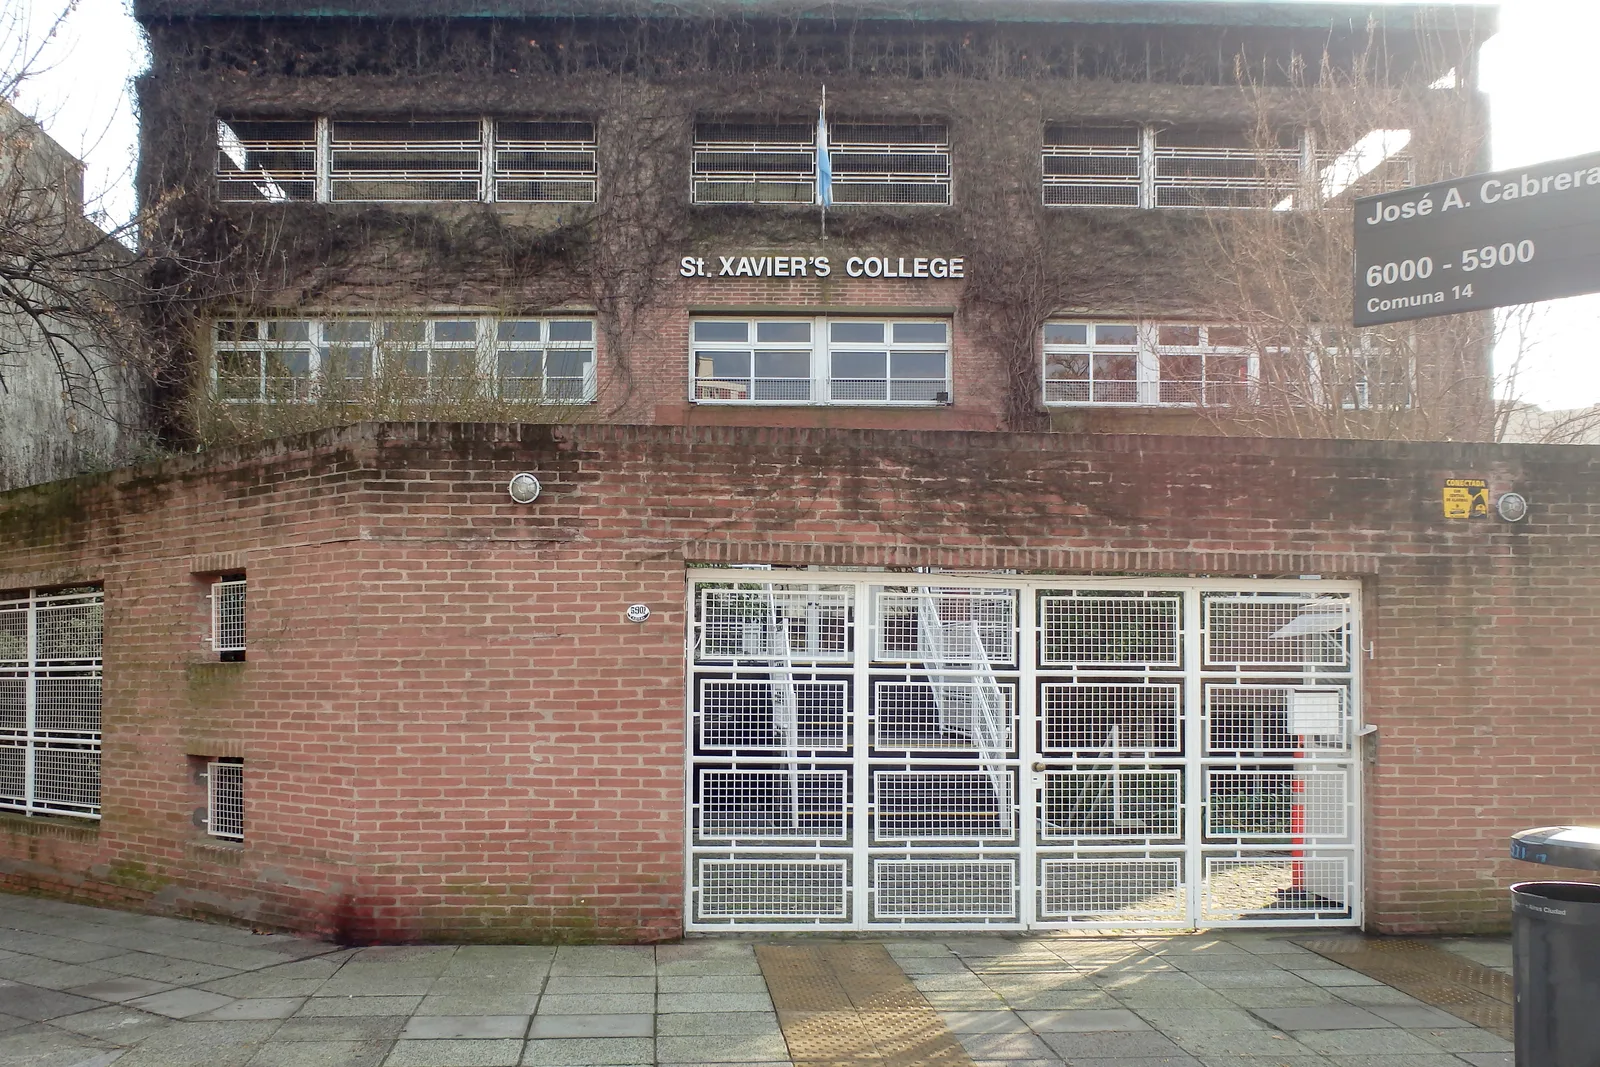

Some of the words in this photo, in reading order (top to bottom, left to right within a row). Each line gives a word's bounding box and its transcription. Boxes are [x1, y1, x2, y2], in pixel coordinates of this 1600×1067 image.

[1366, 192, 1433, 225] José
[1441, 187, 1471, 212] A.
[1480, 166, 1600, 204] Cabrera
[680, 256, 712, 278] St.
[719, 256, 831, 277] XAVIER'S
[846, 257, 964, 278] COLLEGE
[1366, 256, 1433, 287] 6000
[1461, 239, 1535, 272] 5900
[1366, 291, 1444, 313] Comuna
[1451, 283, 1474, 300] 14
[1446, 479, 1486, 487] CONECTADA
[1543, 906, 1566, 916] Ciudad
